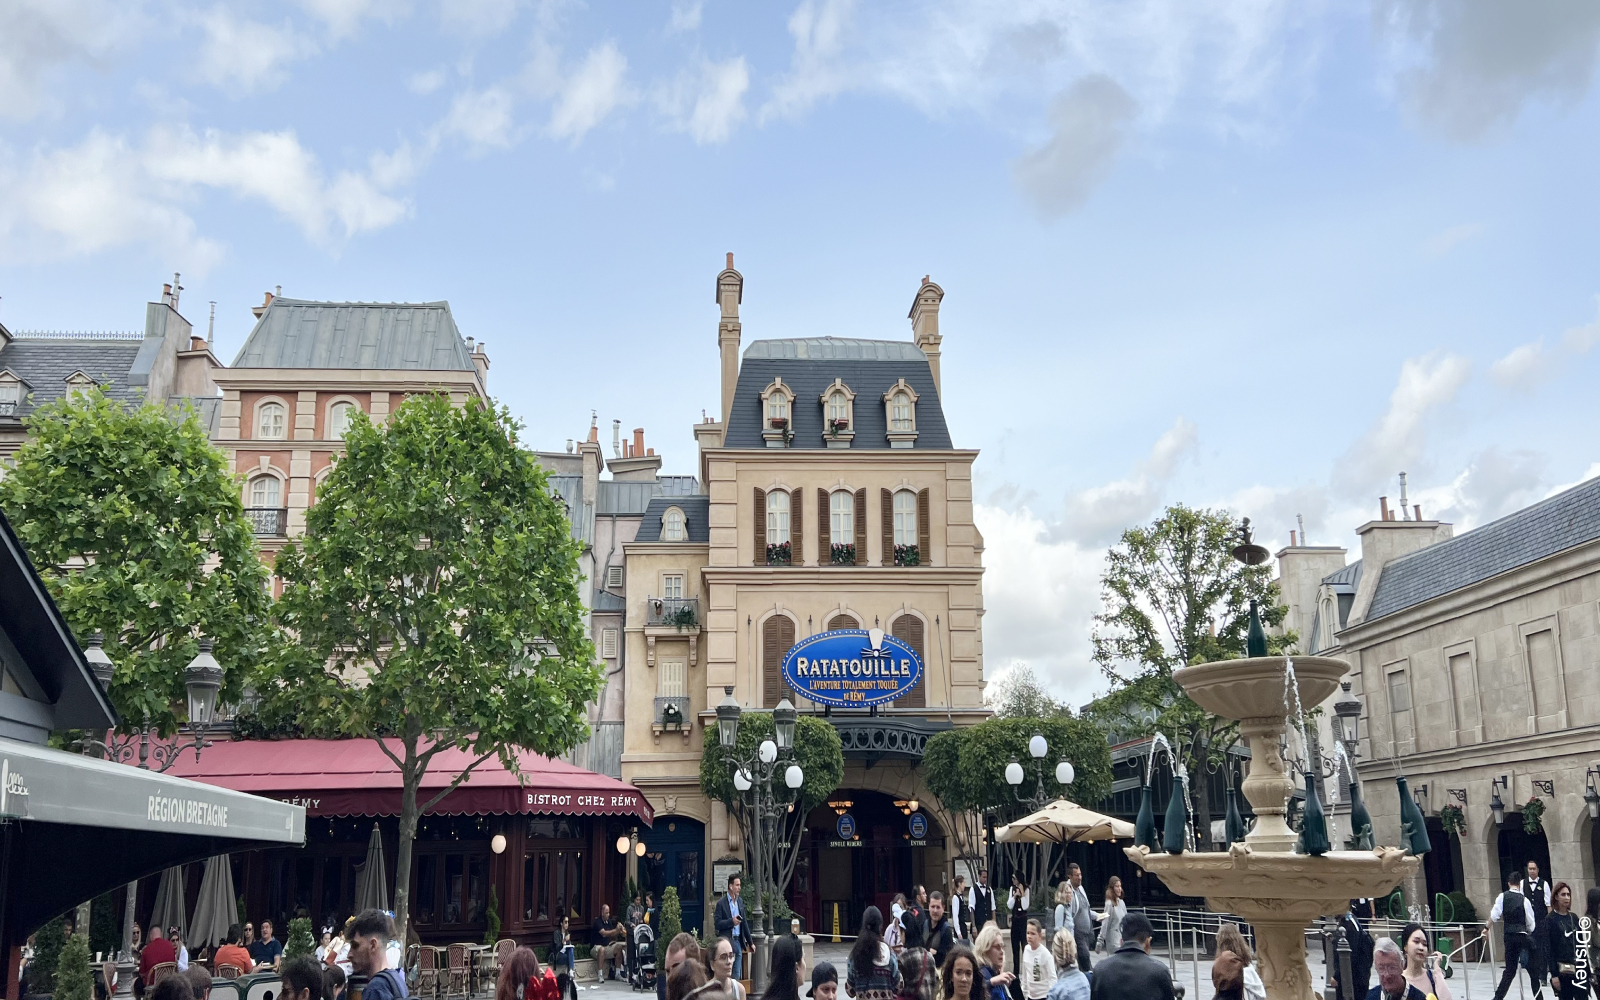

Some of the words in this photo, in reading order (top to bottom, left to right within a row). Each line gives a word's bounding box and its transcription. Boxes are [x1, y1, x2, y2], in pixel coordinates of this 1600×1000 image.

[797, 657, 910, 677] RATATOUILLE
[809, 680, 840, 690] L'AVENTURE
[841, 680, 876, 690] TOTALEMENT
[877, 678, 898, 690] TOQUÉE
[850, 690, 865, 701] RÉMY
[527, 794, 572, 806] BISTROT
[577, 795, 606, 806] CHEZ
[611, 794, 637, 807] RÉMY
[147, 788, 185, 823] RÉGION
[186, 800, 229, 828] BRETAGNE
